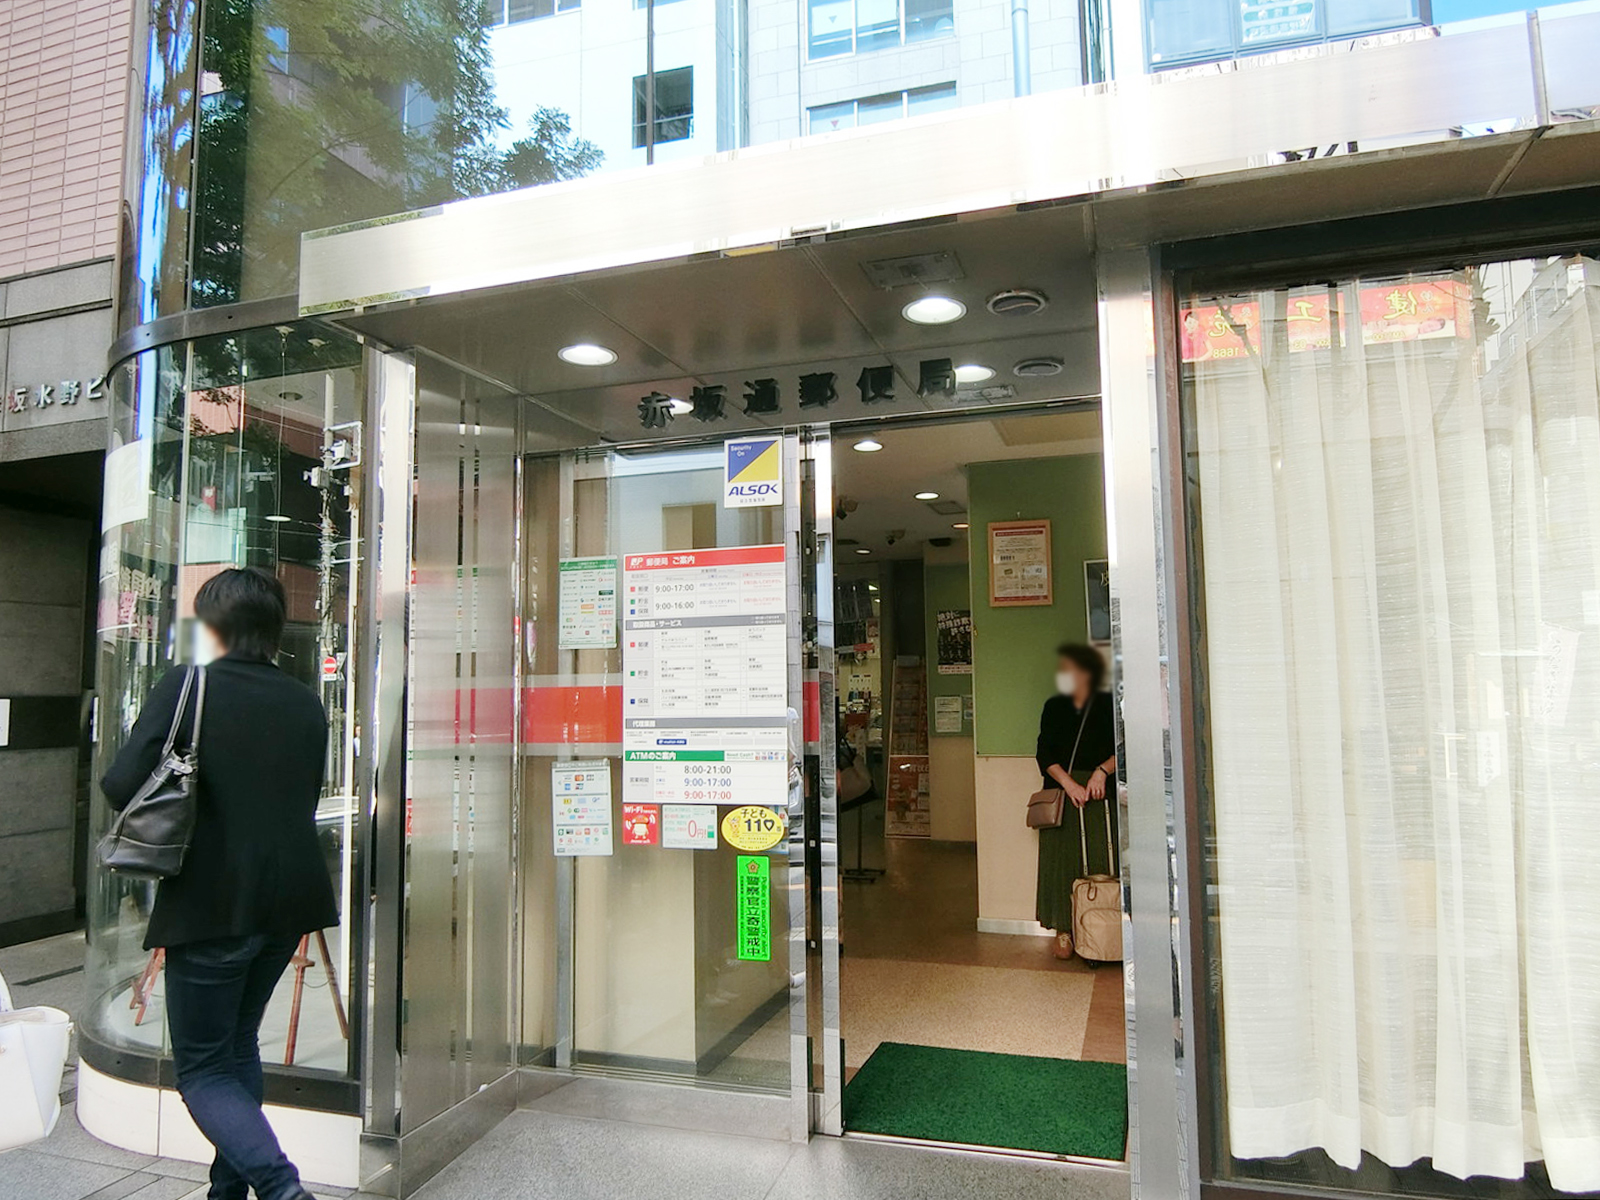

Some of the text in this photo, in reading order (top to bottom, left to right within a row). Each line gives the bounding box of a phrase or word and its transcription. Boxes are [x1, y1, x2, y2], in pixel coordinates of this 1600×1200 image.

[0, 374, 105, 414] 坂水野ビ
[730, 444, 753, 452] Security
[728, 483, 778, 497] ALSOK
[646, 557, 669, 567] 郵便局
[672, 555, 695, 565] ご案内
[655, 583, 694, 593] 9:00-17:00
[655, 601, 695, 611] 9:00-16:00
[630, 751, 677, 761] ATMのご案内
[684, 765, 732, 774] 8:00-21:00
[684, 777, 732, 787] 9:00-17:00
[684, 790, 732, 800] 9:00-17:00
[623, 804, 644, 814] Wi-Fi
[740, 808, 767, 819] 子ども
